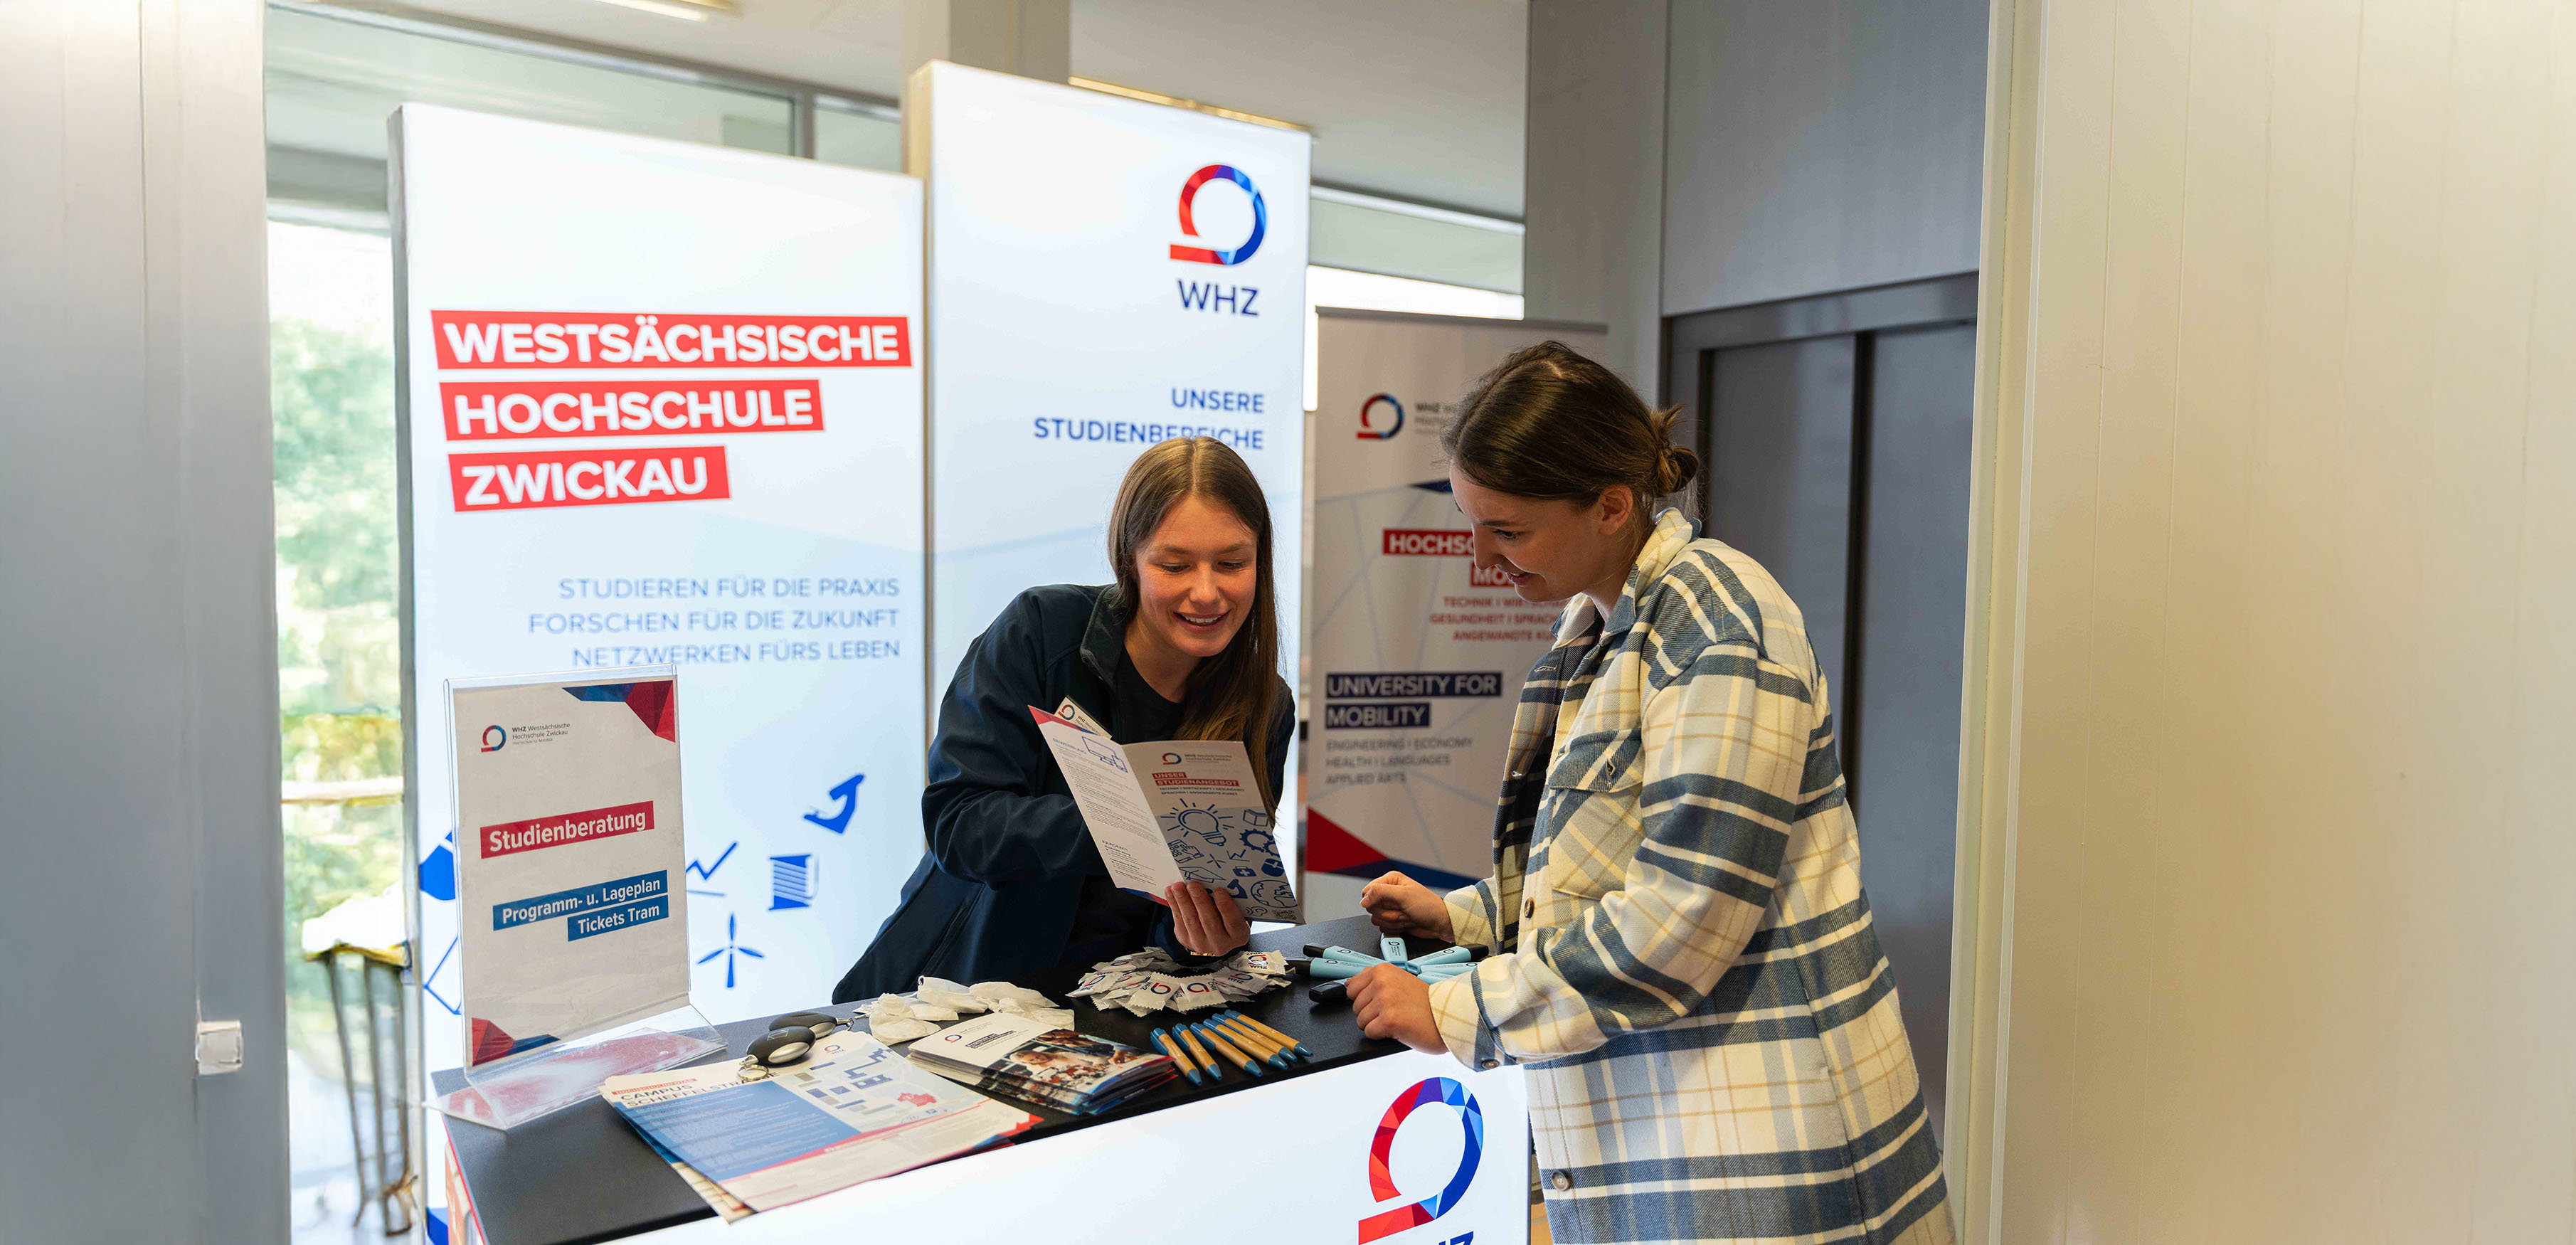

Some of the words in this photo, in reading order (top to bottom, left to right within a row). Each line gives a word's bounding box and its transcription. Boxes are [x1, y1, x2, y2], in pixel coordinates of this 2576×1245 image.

[1177, 279, 1259, 317] WHZ
[443, 314, 901, 364] WESTSÄCHSISCHE
[454, 388, 814, 435] HOCHSCHULE
[1171, 388, 1264, 413] UNSERE
[1034, 417, 1263, 450] STUDIENBEREICHE
[462, 456, 709, 506] ZWICKAU
[1389, 534, 1474, 553] HOCHSC
[558, 578, 709, 600] STUDIEREN
[717, 573, 765, 598] FÜR
[773, 577, 812, 597] DIE
[818, 577, 901, 597] PRAXIS
[529, 611, 679, 635] FORSCHEN
[687, 608, 738, 630] FÜR
[745, 610, 783, 630] DIE
[792, 608, 901, 630] ZUKUNFT
[572, 643, 751, 667] NETZWERKEN
[759, 640, 821, 662] FÜRS
[827, 640, 901, 661] LEBEN
[1327, 676, 1451, 696] UNIVERSITY
[1454, 674, 1498, 694] FOR
[528, 723, 571, 731] Westsächsische
[1327, 705, 1426, 726] MOBILITY
[1326, 739, 1405, 751] ENGINEERING
[1414, 738, 1473, 750] ECONOMY
[1325, 756, 1373, 768] HEALTH
[1381, 754, 1451, 766] LANGUAGES
[1326, 773, 1374, 784] APPLIED
[1377, 772, 1406, 783] ARTS
[489, 810, 647, 852] Studienberatung
[502, 897, 583, 924] Programm-
[586, 893, 600, 906] u.
[602, 877, 661, 904] Lageplan
[578, 912, 625, 935] Tickets
[627, 904, 661, 923] Tram
[620, 1084, 693, 1101] CAMPUS
